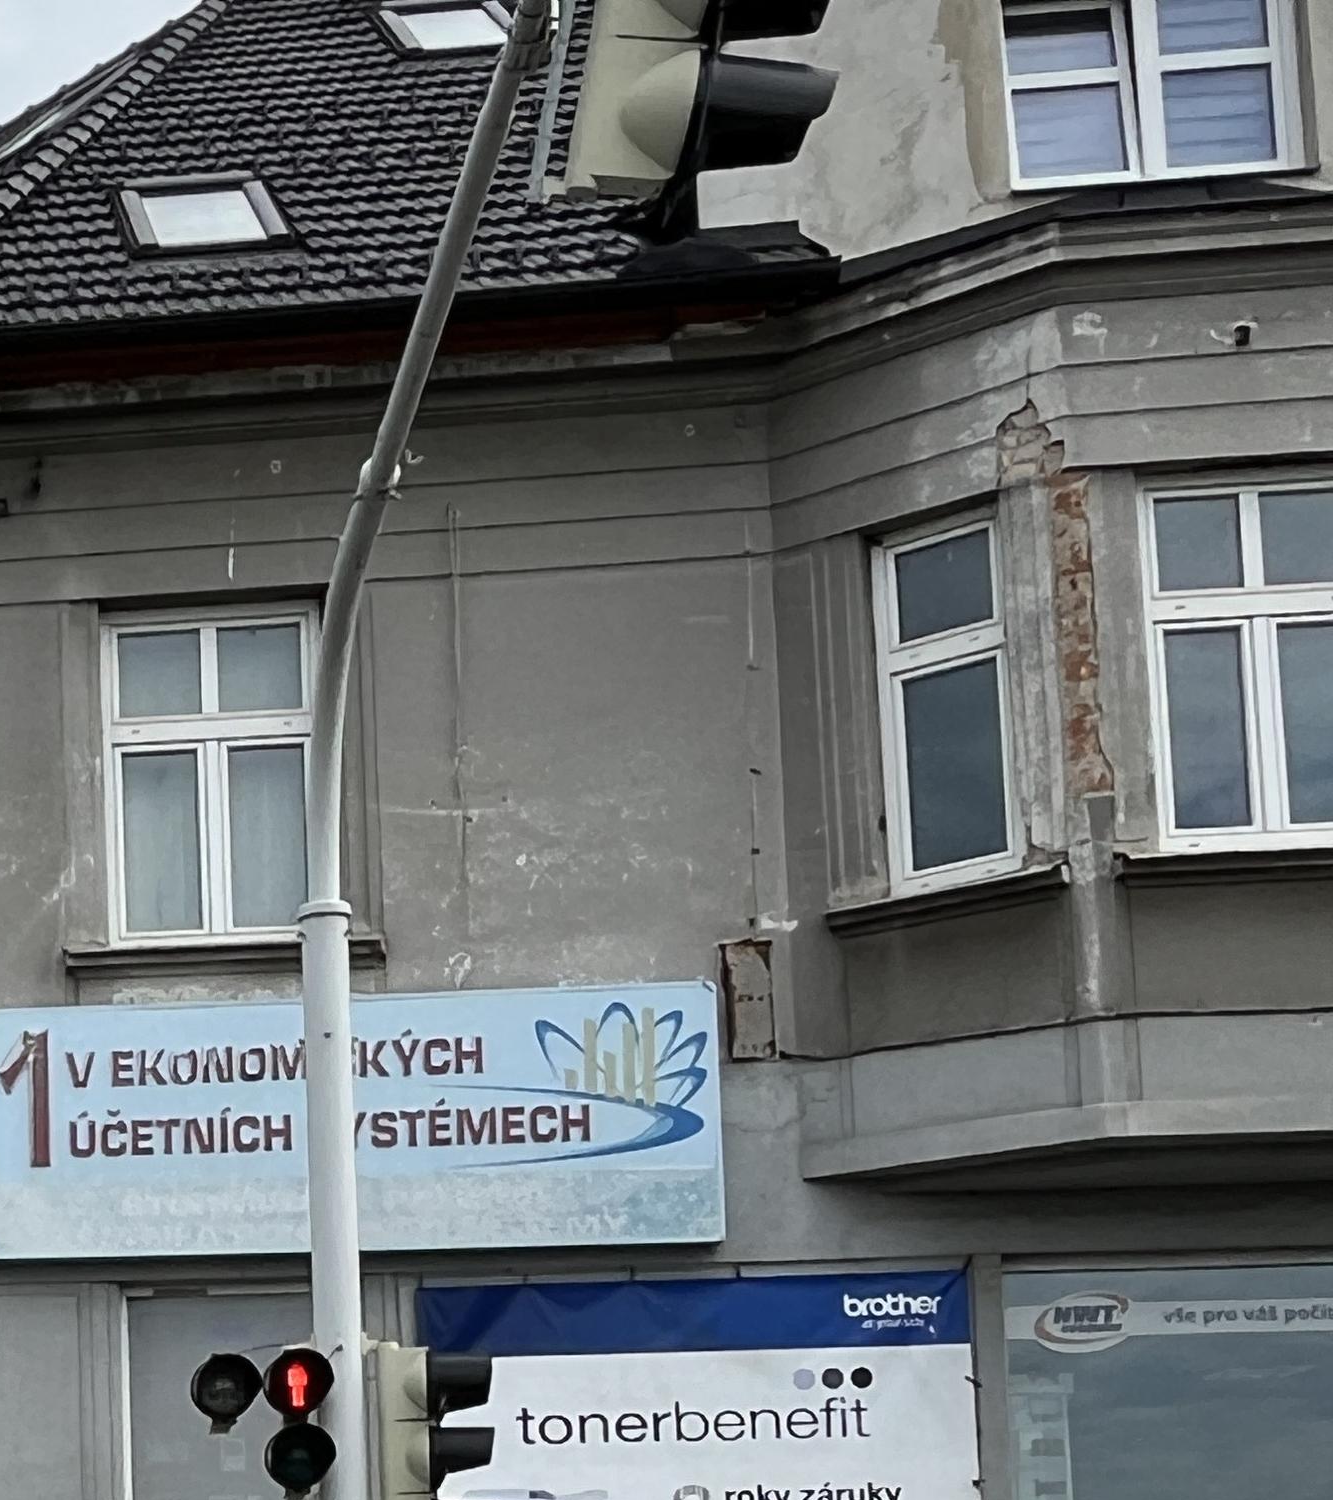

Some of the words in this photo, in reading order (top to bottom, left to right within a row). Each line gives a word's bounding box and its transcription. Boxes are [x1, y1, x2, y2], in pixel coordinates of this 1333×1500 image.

[65, 1051, 96, 1088] V
[111, 1028, 484, 1087] EKONOMKÝCH
[69, 1107, 293, 1158] ÚČETNÍCH
[354, 1098, 591, 1148] STÉMECH
[843, 1293, 942, 1317] brother
[1053, 1305, 1119, 1324] NWT
[1203, 1310, 1238, 1326] pro
[516, 1397, 872, 1445] tonerbenefit
